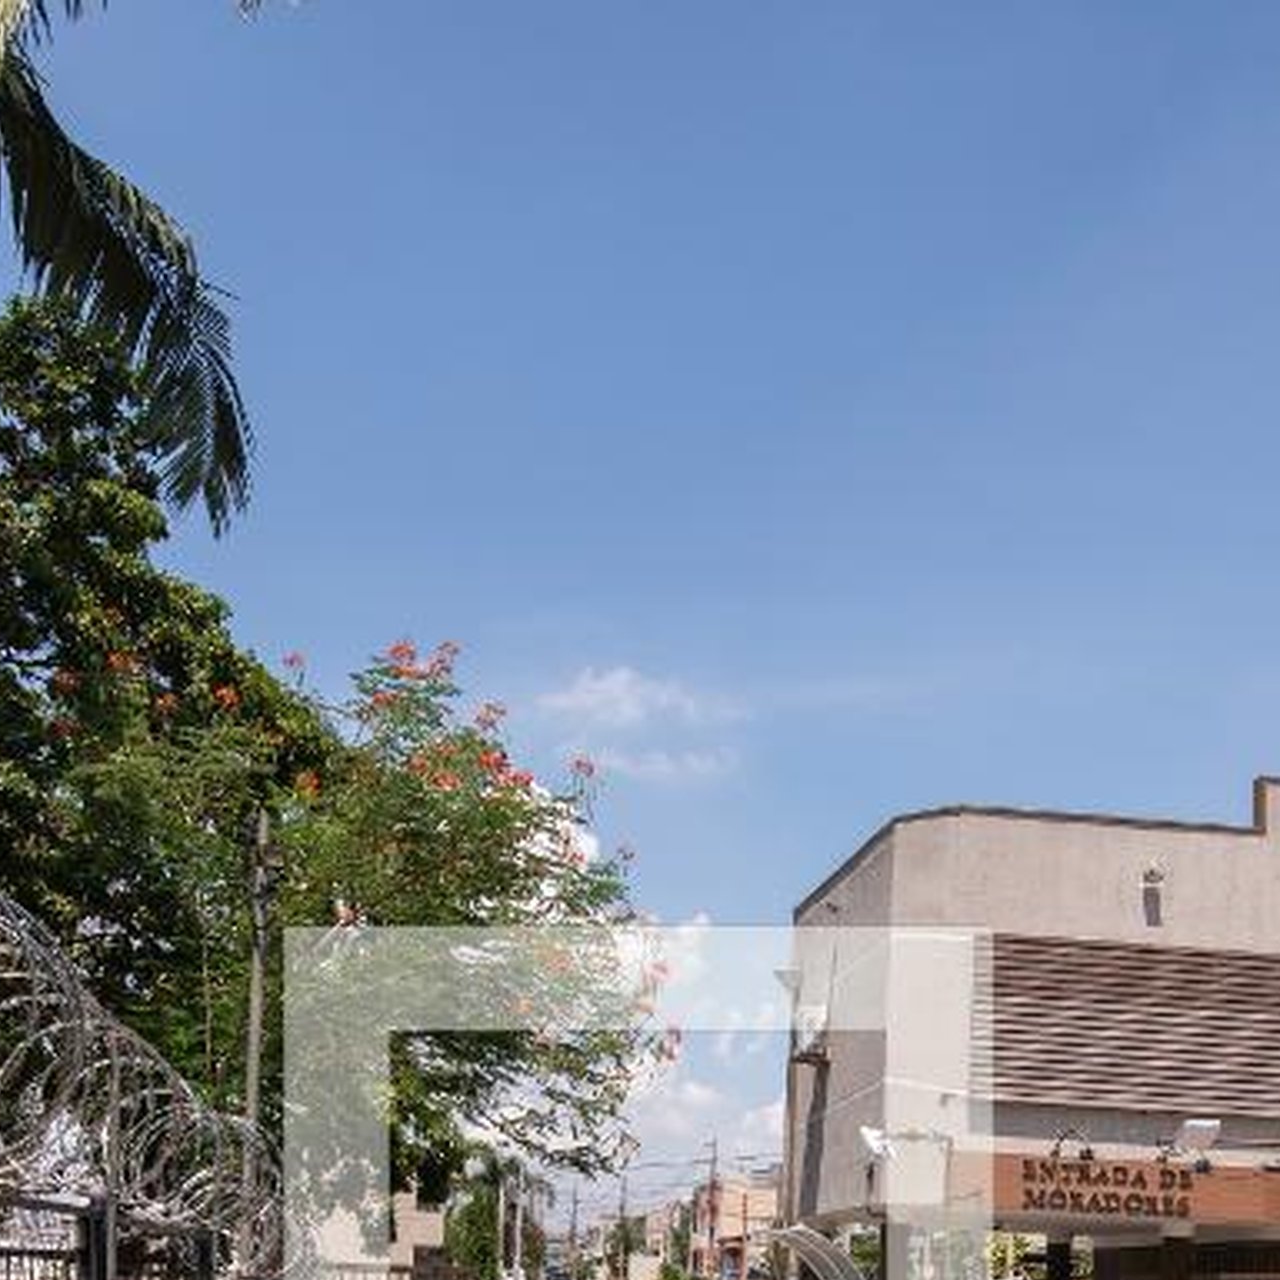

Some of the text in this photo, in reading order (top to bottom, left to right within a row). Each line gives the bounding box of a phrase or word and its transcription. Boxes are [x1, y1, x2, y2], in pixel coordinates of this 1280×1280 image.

[1022, 1159, 1194, 1191] ENTRADA DE
[1022, 1190, 1190, 1218] MORADORES
